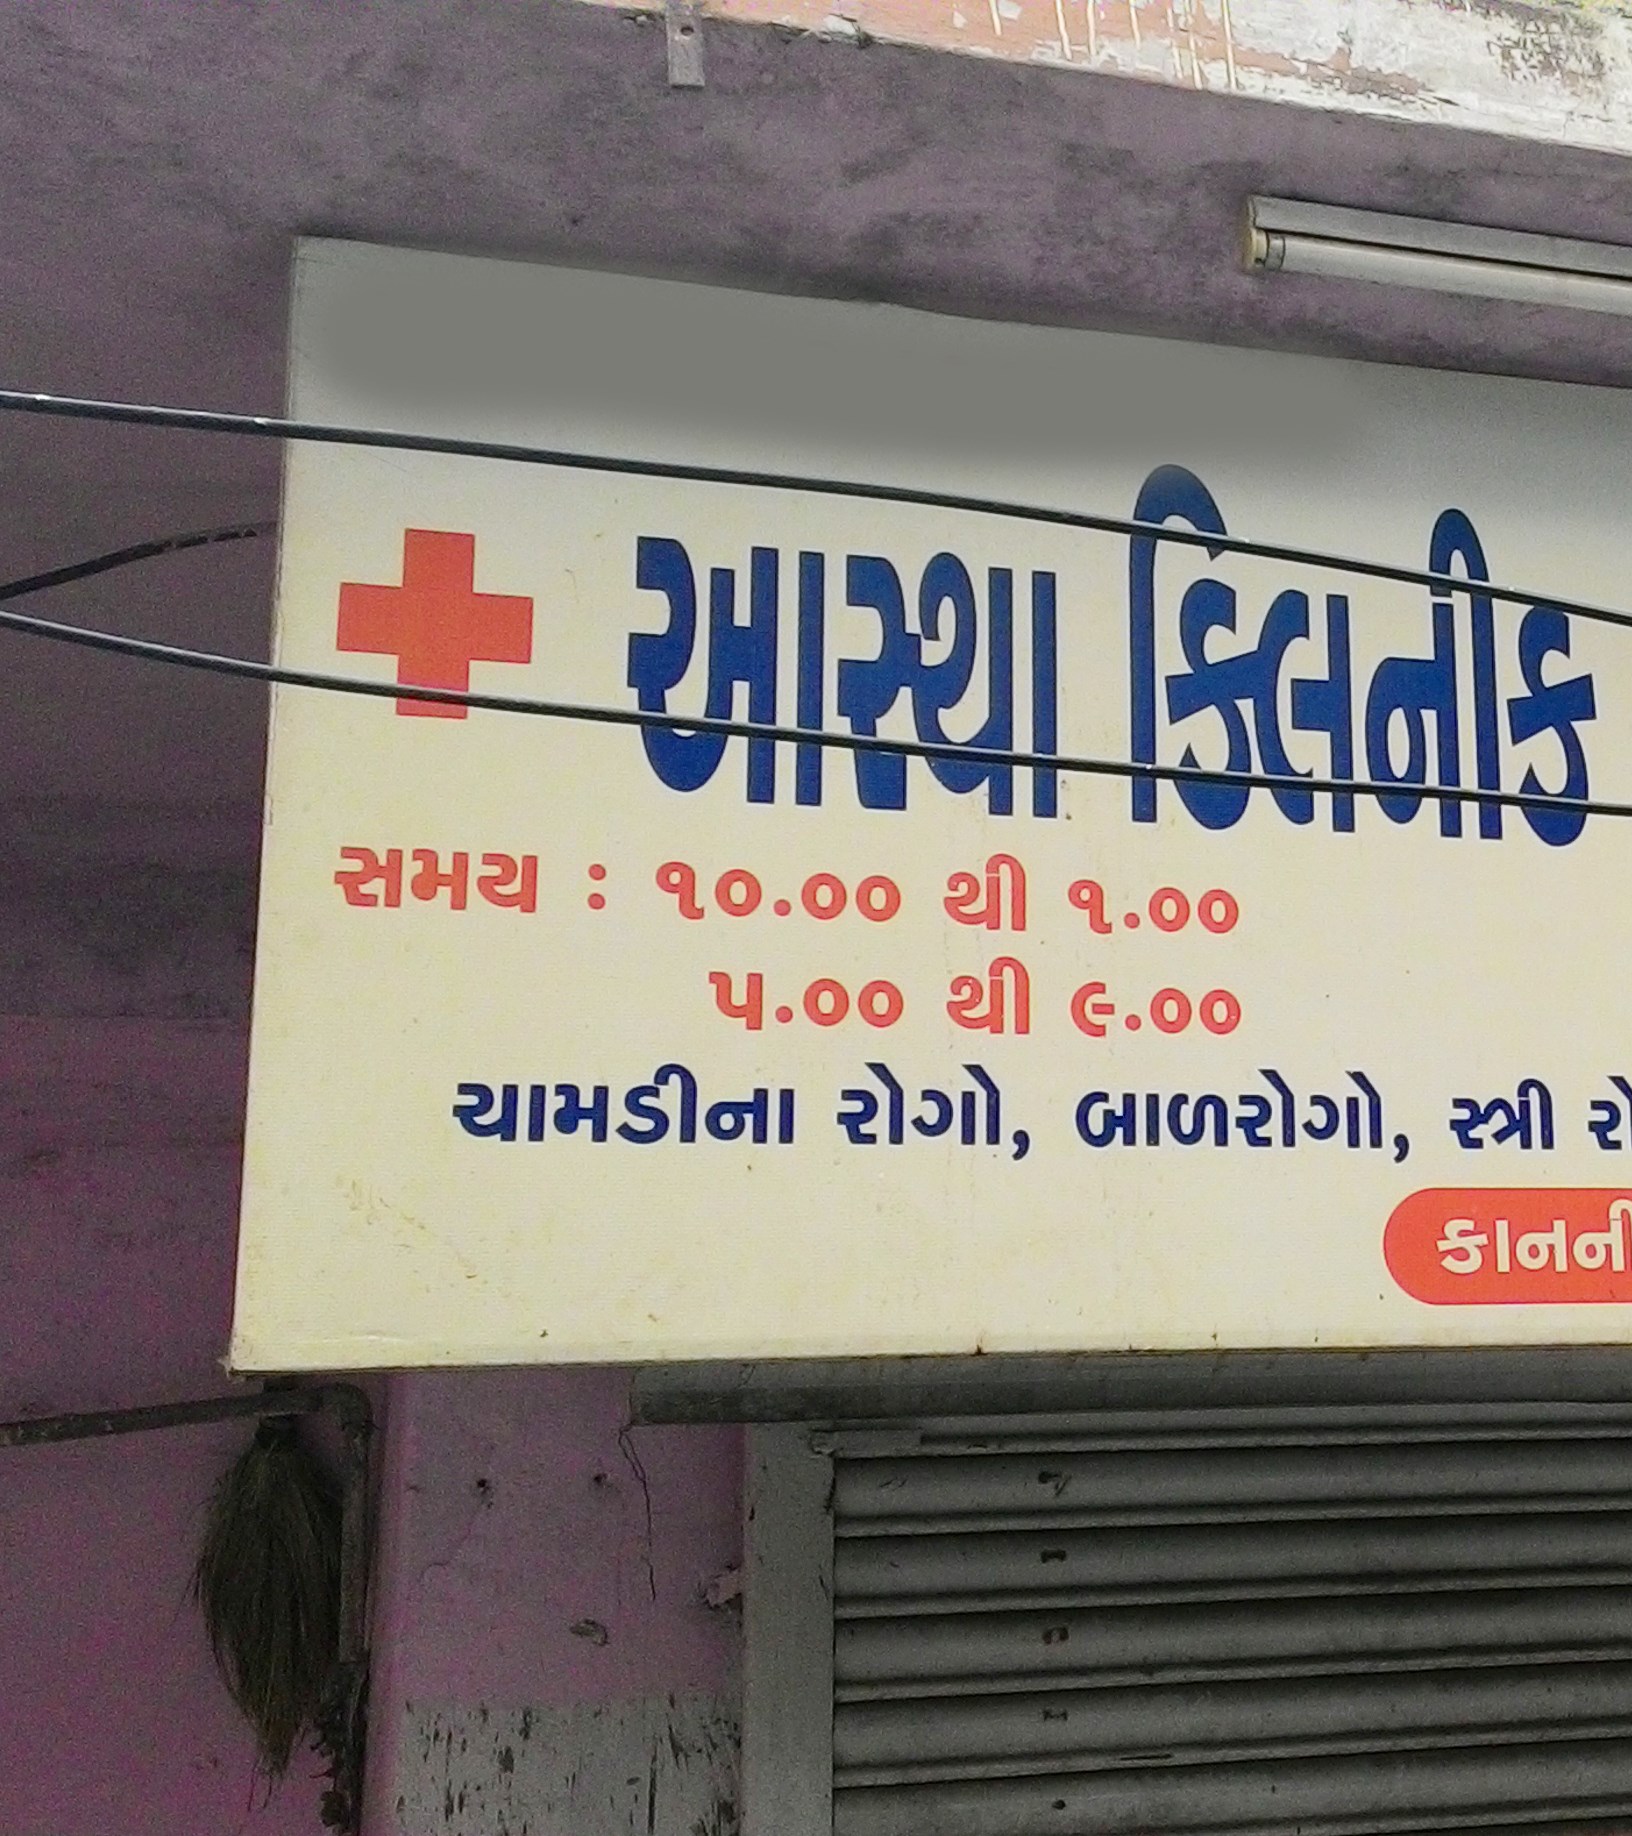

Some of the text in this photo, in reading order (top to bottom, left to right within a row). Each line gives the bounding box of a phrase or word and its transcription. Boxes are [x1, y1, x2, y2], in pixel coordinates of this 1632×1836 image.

[627, 536, 1057, 818] આસ્થા
[334, 848, 538, 913] સમય
[656, 861, 901, 922] ૧૦.૦૦
[944, 853, 1026, 932] થી
[1068, 880, 1238, 934] ૧.૦૦
[947, 956, 1030, 1035] થી
[1070, 981, 1241, 1037] ૯.૦૦
[453, 1064, 794, 1144] ચામડીના
[837, 1063, 1030, 1160] રોગો,
[1076, 1069, 1409, 1163] બાળરોગો,
[1450, 1079, 1554, 1149] સ્ત્રી
